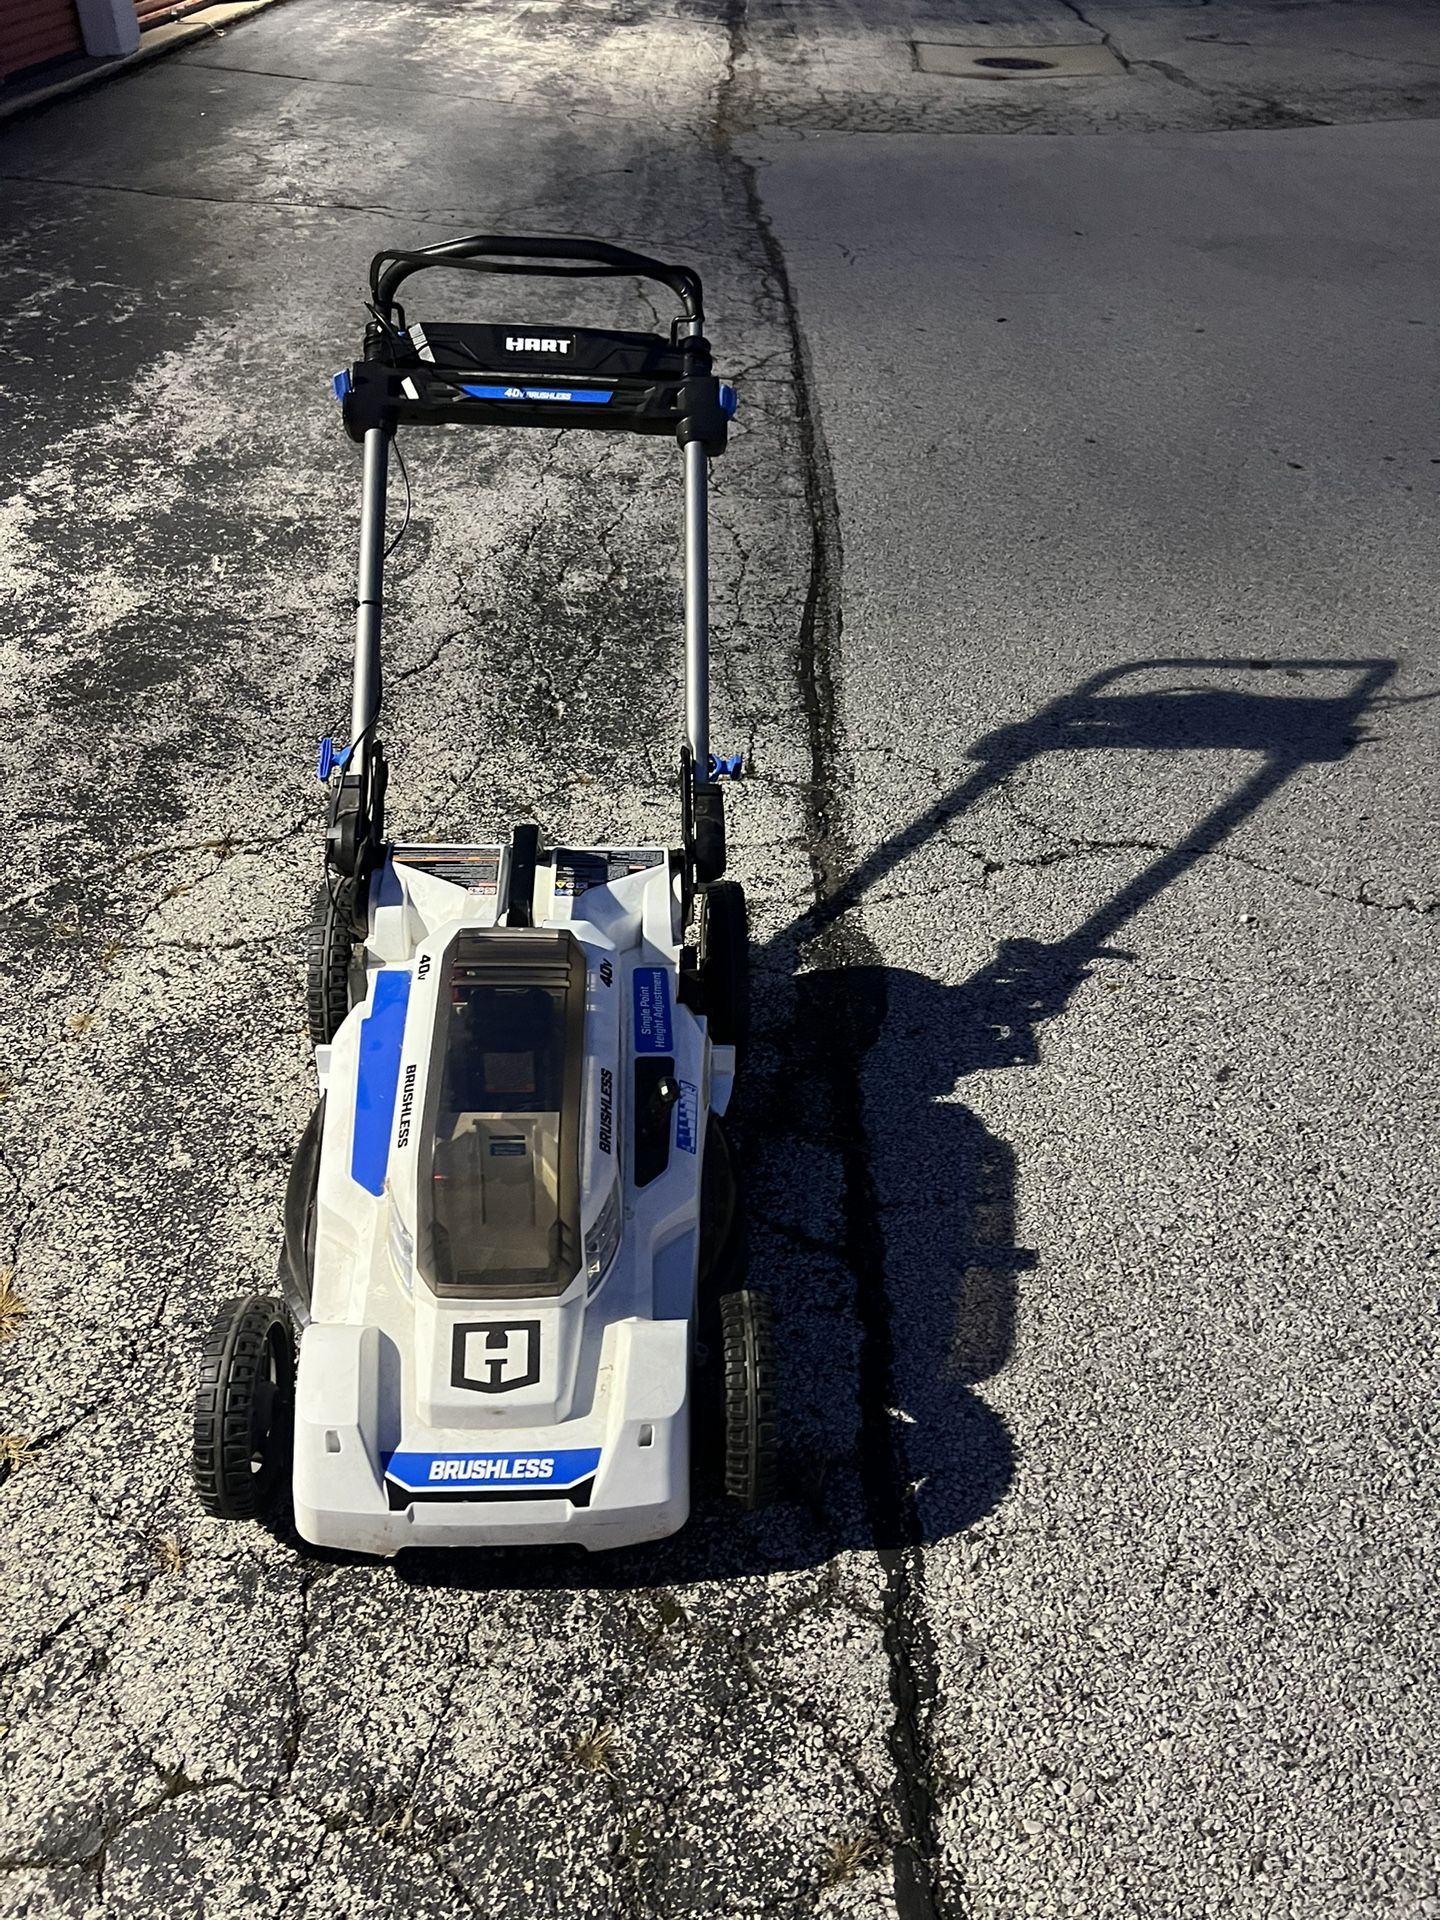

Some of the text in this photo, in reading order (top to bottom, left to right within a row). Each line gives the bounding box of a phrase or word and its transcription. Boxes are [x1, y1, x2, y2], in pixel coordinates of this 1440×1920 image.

[505, 337, 571, 354] HART
[640, 985, 652, 1035] Single Point
[652, 971, 666, 1048] Height Adjustment
[397, 1064, 417, 1148] BRUSHLESS
[599, 1068, 613, 1155] BRUSHLESS
[428, 1458, 554, 1480] BRUSHLESS
